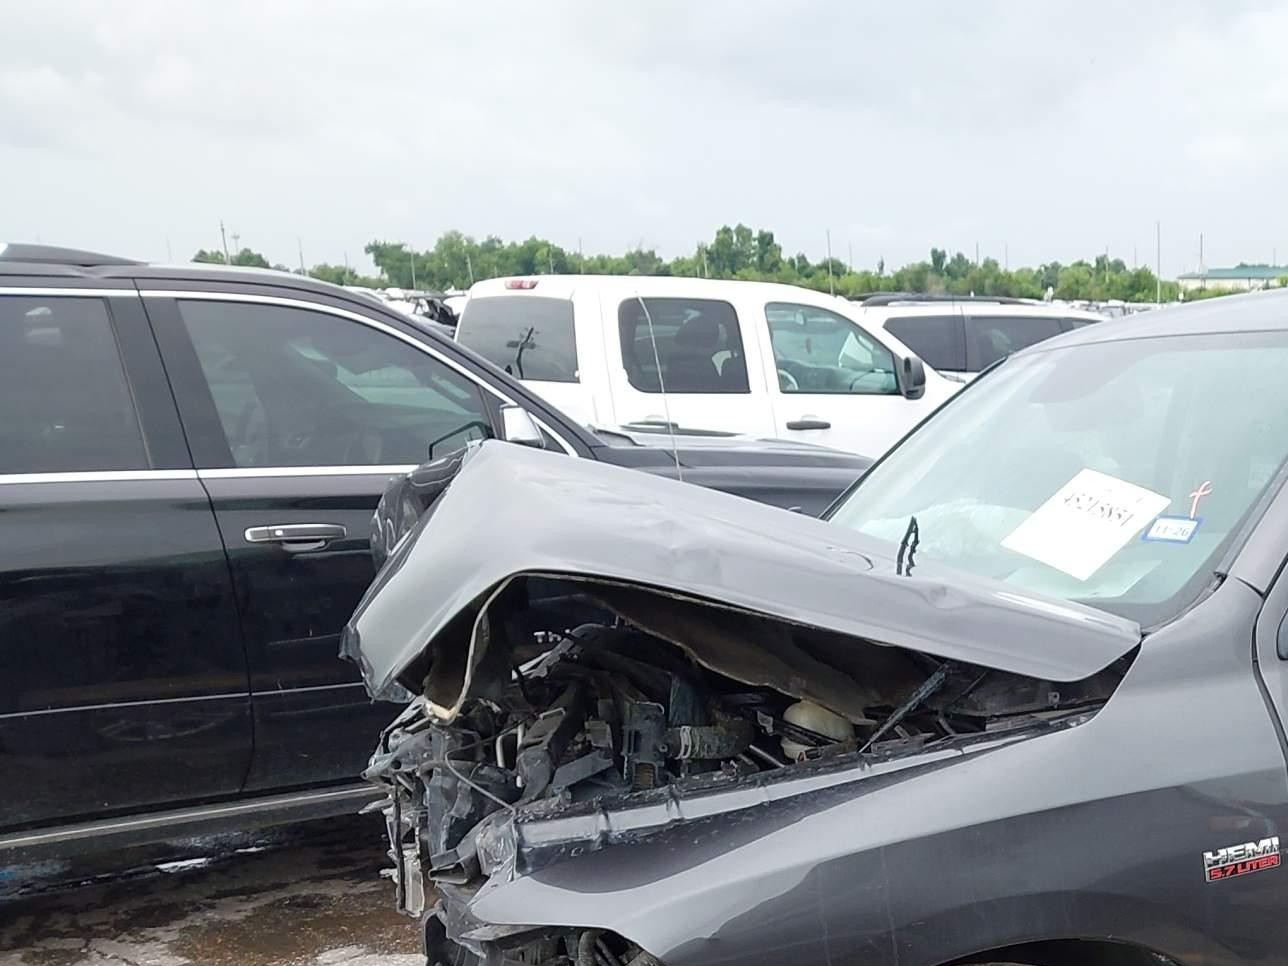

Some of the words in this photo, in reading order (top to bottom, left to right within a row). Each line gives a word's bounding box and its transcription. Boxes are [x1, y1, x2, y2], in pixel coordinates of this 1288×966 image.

[1203, 836, 1280, 867] HEMI
[1210, 864, 1234, 881] 5.7
[1236, 855, 1279, 875] LITER
